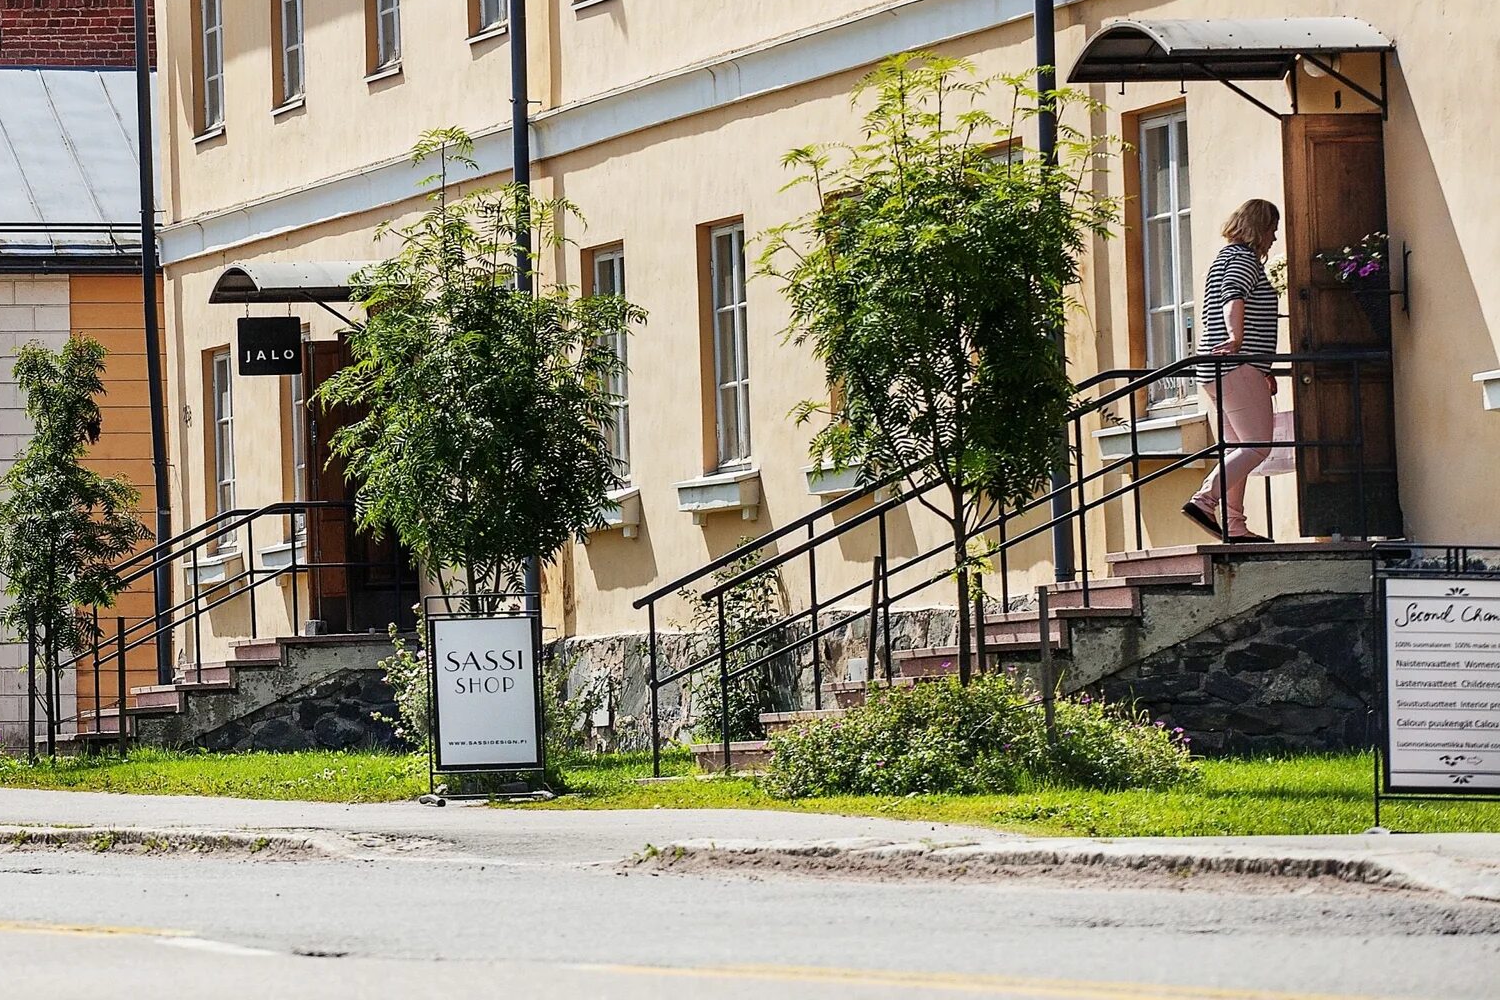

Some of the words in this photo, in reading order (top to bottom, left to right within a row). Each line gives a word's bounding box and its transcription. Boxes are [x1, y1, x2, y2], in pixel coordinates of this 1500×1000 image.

[246, 349, 294, 363] JALO
[1395, 602, 1455, 627] Second
[444, 650, 523, 672] SASSI
[454, 676, 515, 694] SHOP
